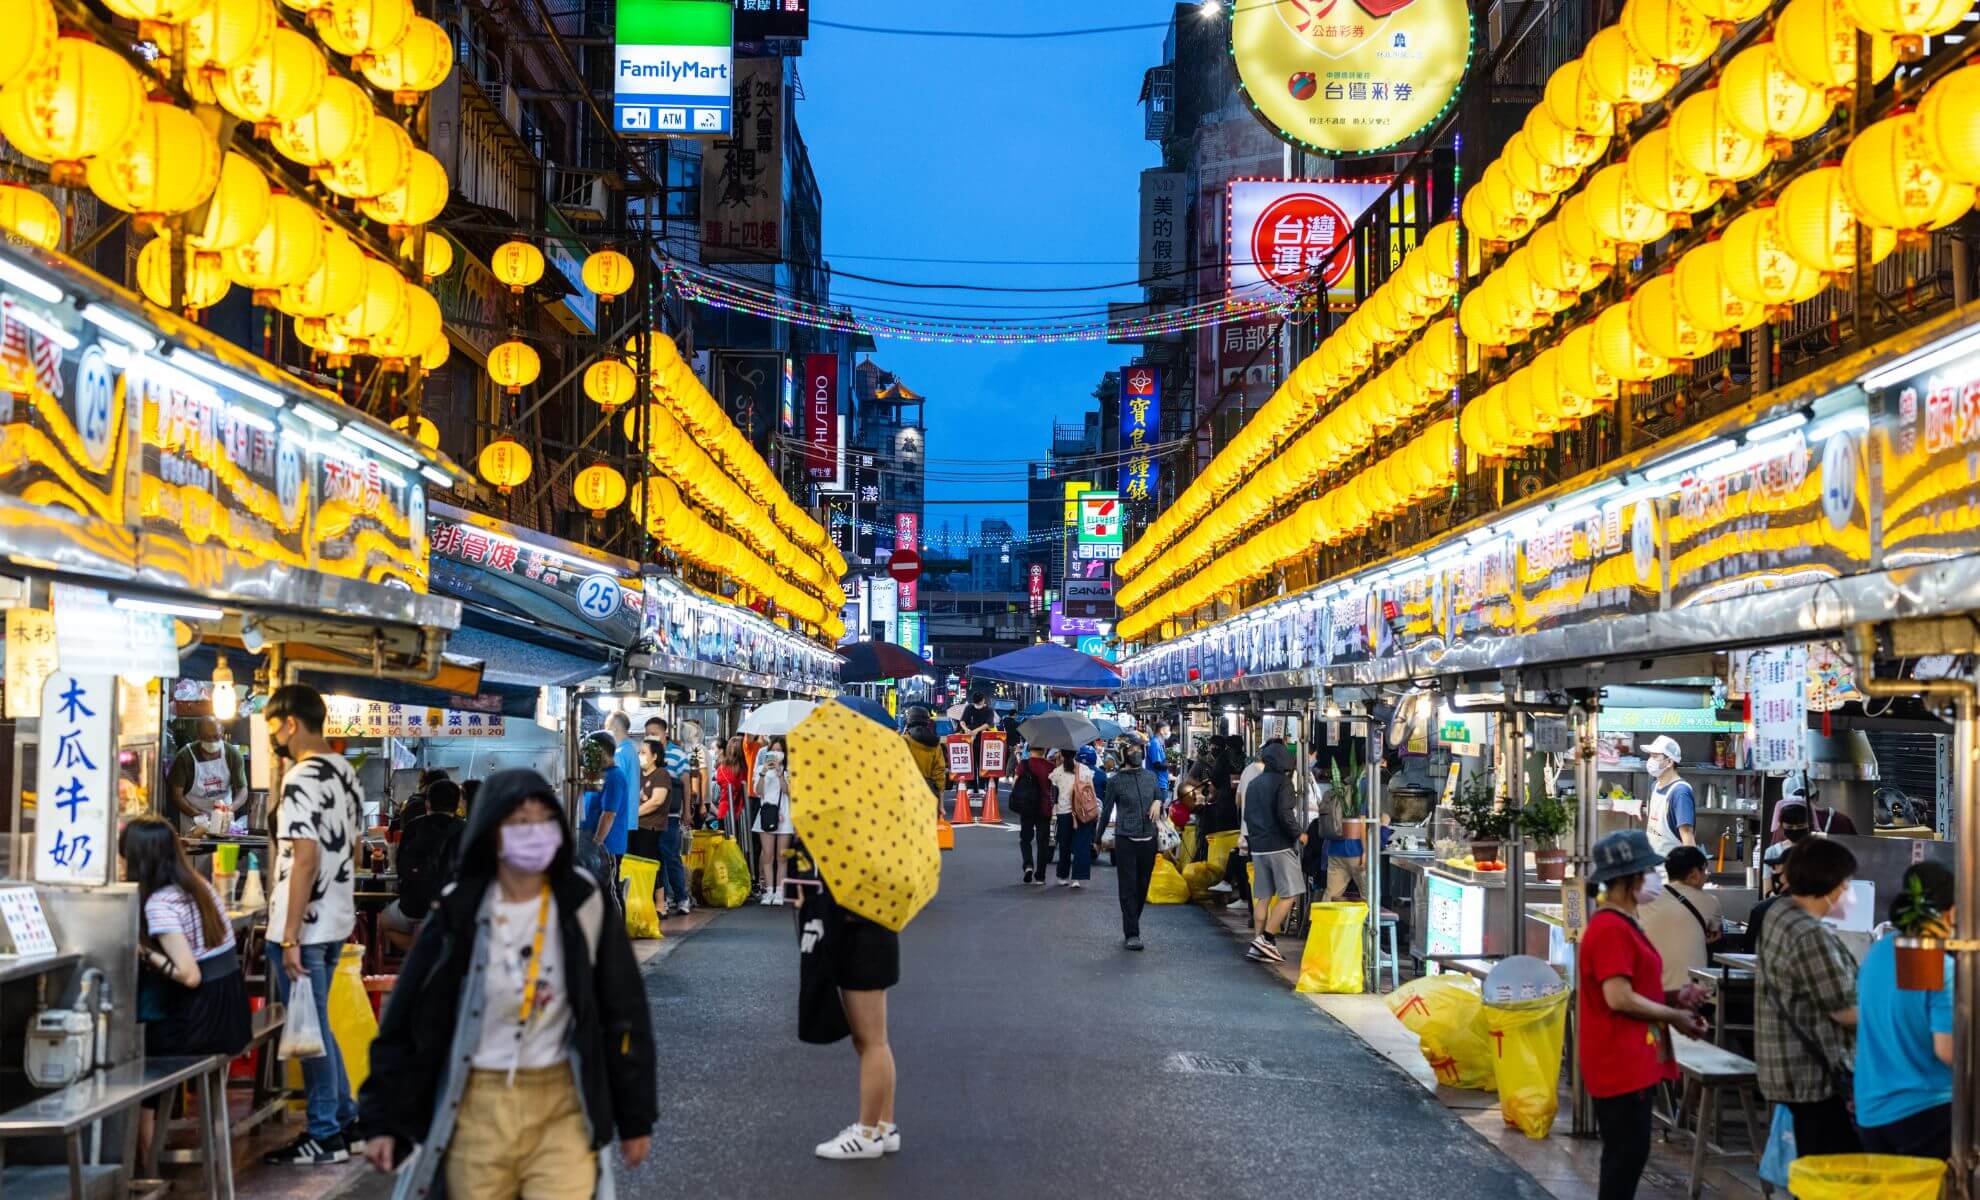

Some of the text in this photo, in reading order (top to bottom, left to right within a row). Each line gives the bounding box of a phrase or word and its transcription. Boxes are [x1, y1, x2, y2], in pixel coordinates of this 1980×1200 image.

[1312, 25, 1365, 37] 公益彩券
[620, 60, 727, 82] FamilyMart
[1325, 82, 1412, 101] 台灣彩券
[663, 113, 682, 126] ATM
[1153, 196, 1173, 281] 美的假髮
[1273, 214, 1336, 246] 台灣
[813, 375, 829, 460] SHISEIDO
[431, 523, 520, 573] 排骨焿
[584, 581, 614, 614] 25
[48, 677, 99, 871] 木瓜牛奶
[952, 756, 969, 764] 口罩
